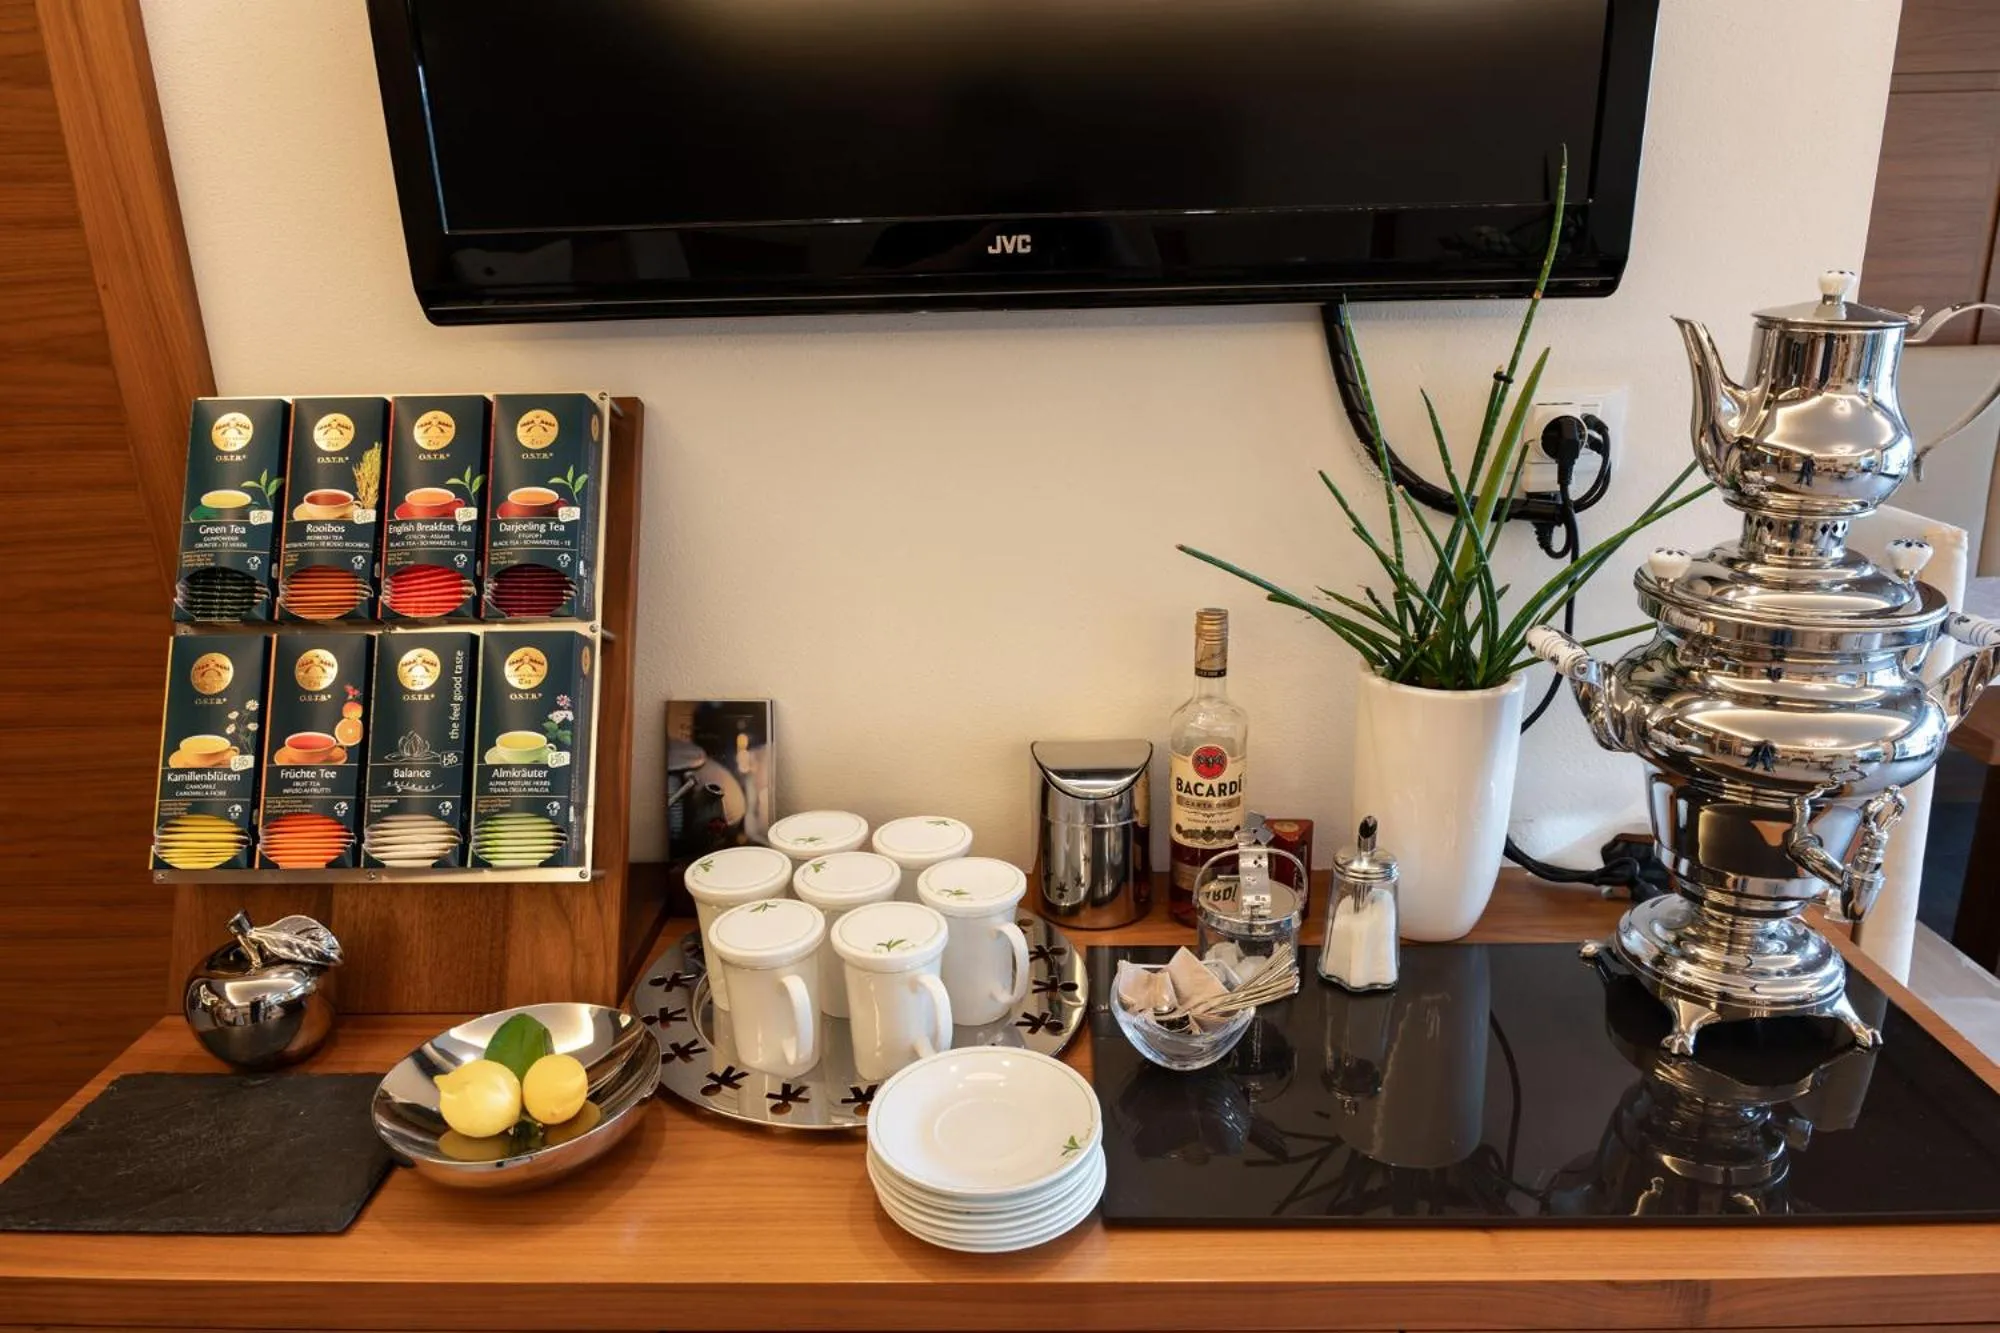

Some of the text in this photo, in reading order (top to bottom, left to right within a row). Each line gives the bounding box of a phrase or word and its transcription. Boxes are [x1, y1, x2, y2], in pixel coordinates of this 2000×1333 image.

[987, 234, 1032, 254] JVC
[199, 525, 247, 535] Green Tea
[305, 523, 346, 533] Rooibos
[388, 522, 473, 535] English Breakfast Tea
[499, 522, 565, 533] Darjeeling Tea
[449, 649, 464, 740] the feel good taste
[167, 771, 241, 782] Kamillenblüten
[280, 768, 337, 779] Früchte Tee
[393, 768, 432, 778] Balance
[491, 767, 549, 778] Almkräuter
